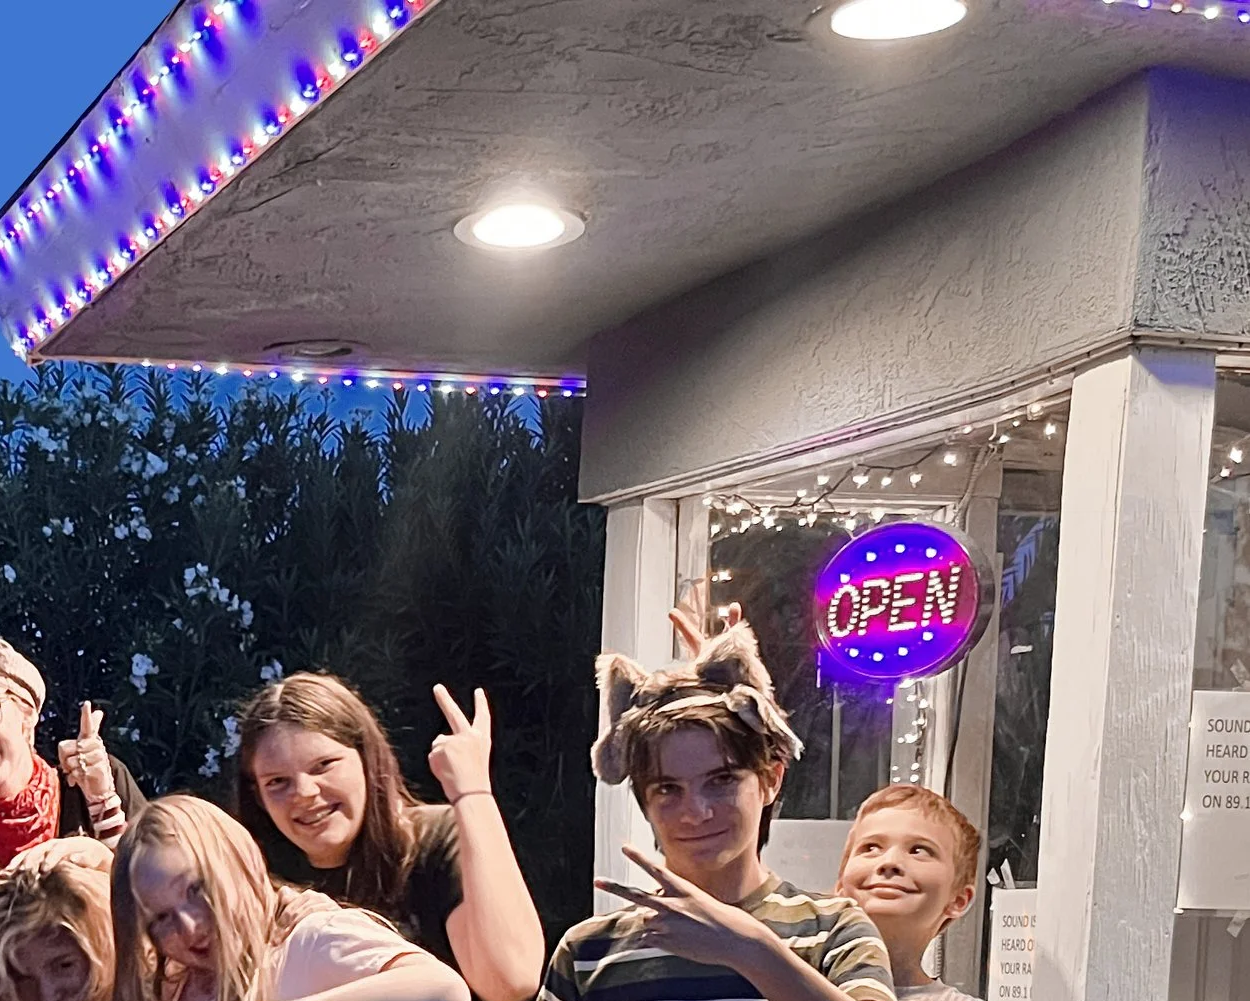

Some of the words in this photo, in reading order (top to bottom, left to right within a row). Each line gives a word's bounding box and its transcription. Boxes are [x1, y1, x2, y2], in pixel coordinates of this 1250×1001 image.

[828, 565, 961, 637] OPEN
[1207, 719, 1250, 733] SOUND
[1206, 744, 1248, 758] HEARD
[1204, 770, 1239, 784] YOUR
[1242, 770, 1250, 784] R
[1202, 795, 1221, 809] ON
[1002, 915, 1029, 928] SOUND
[1001, 939, 1026, 951] HEARD
[1027, 939, 1034, 951] O
[1000, 962, 1021, 975] YOUR
[1022, 963, 1032, 975] RA
[999, 985, 1010, 998] ON
[1011, 986, 1028, 999] 89.1
